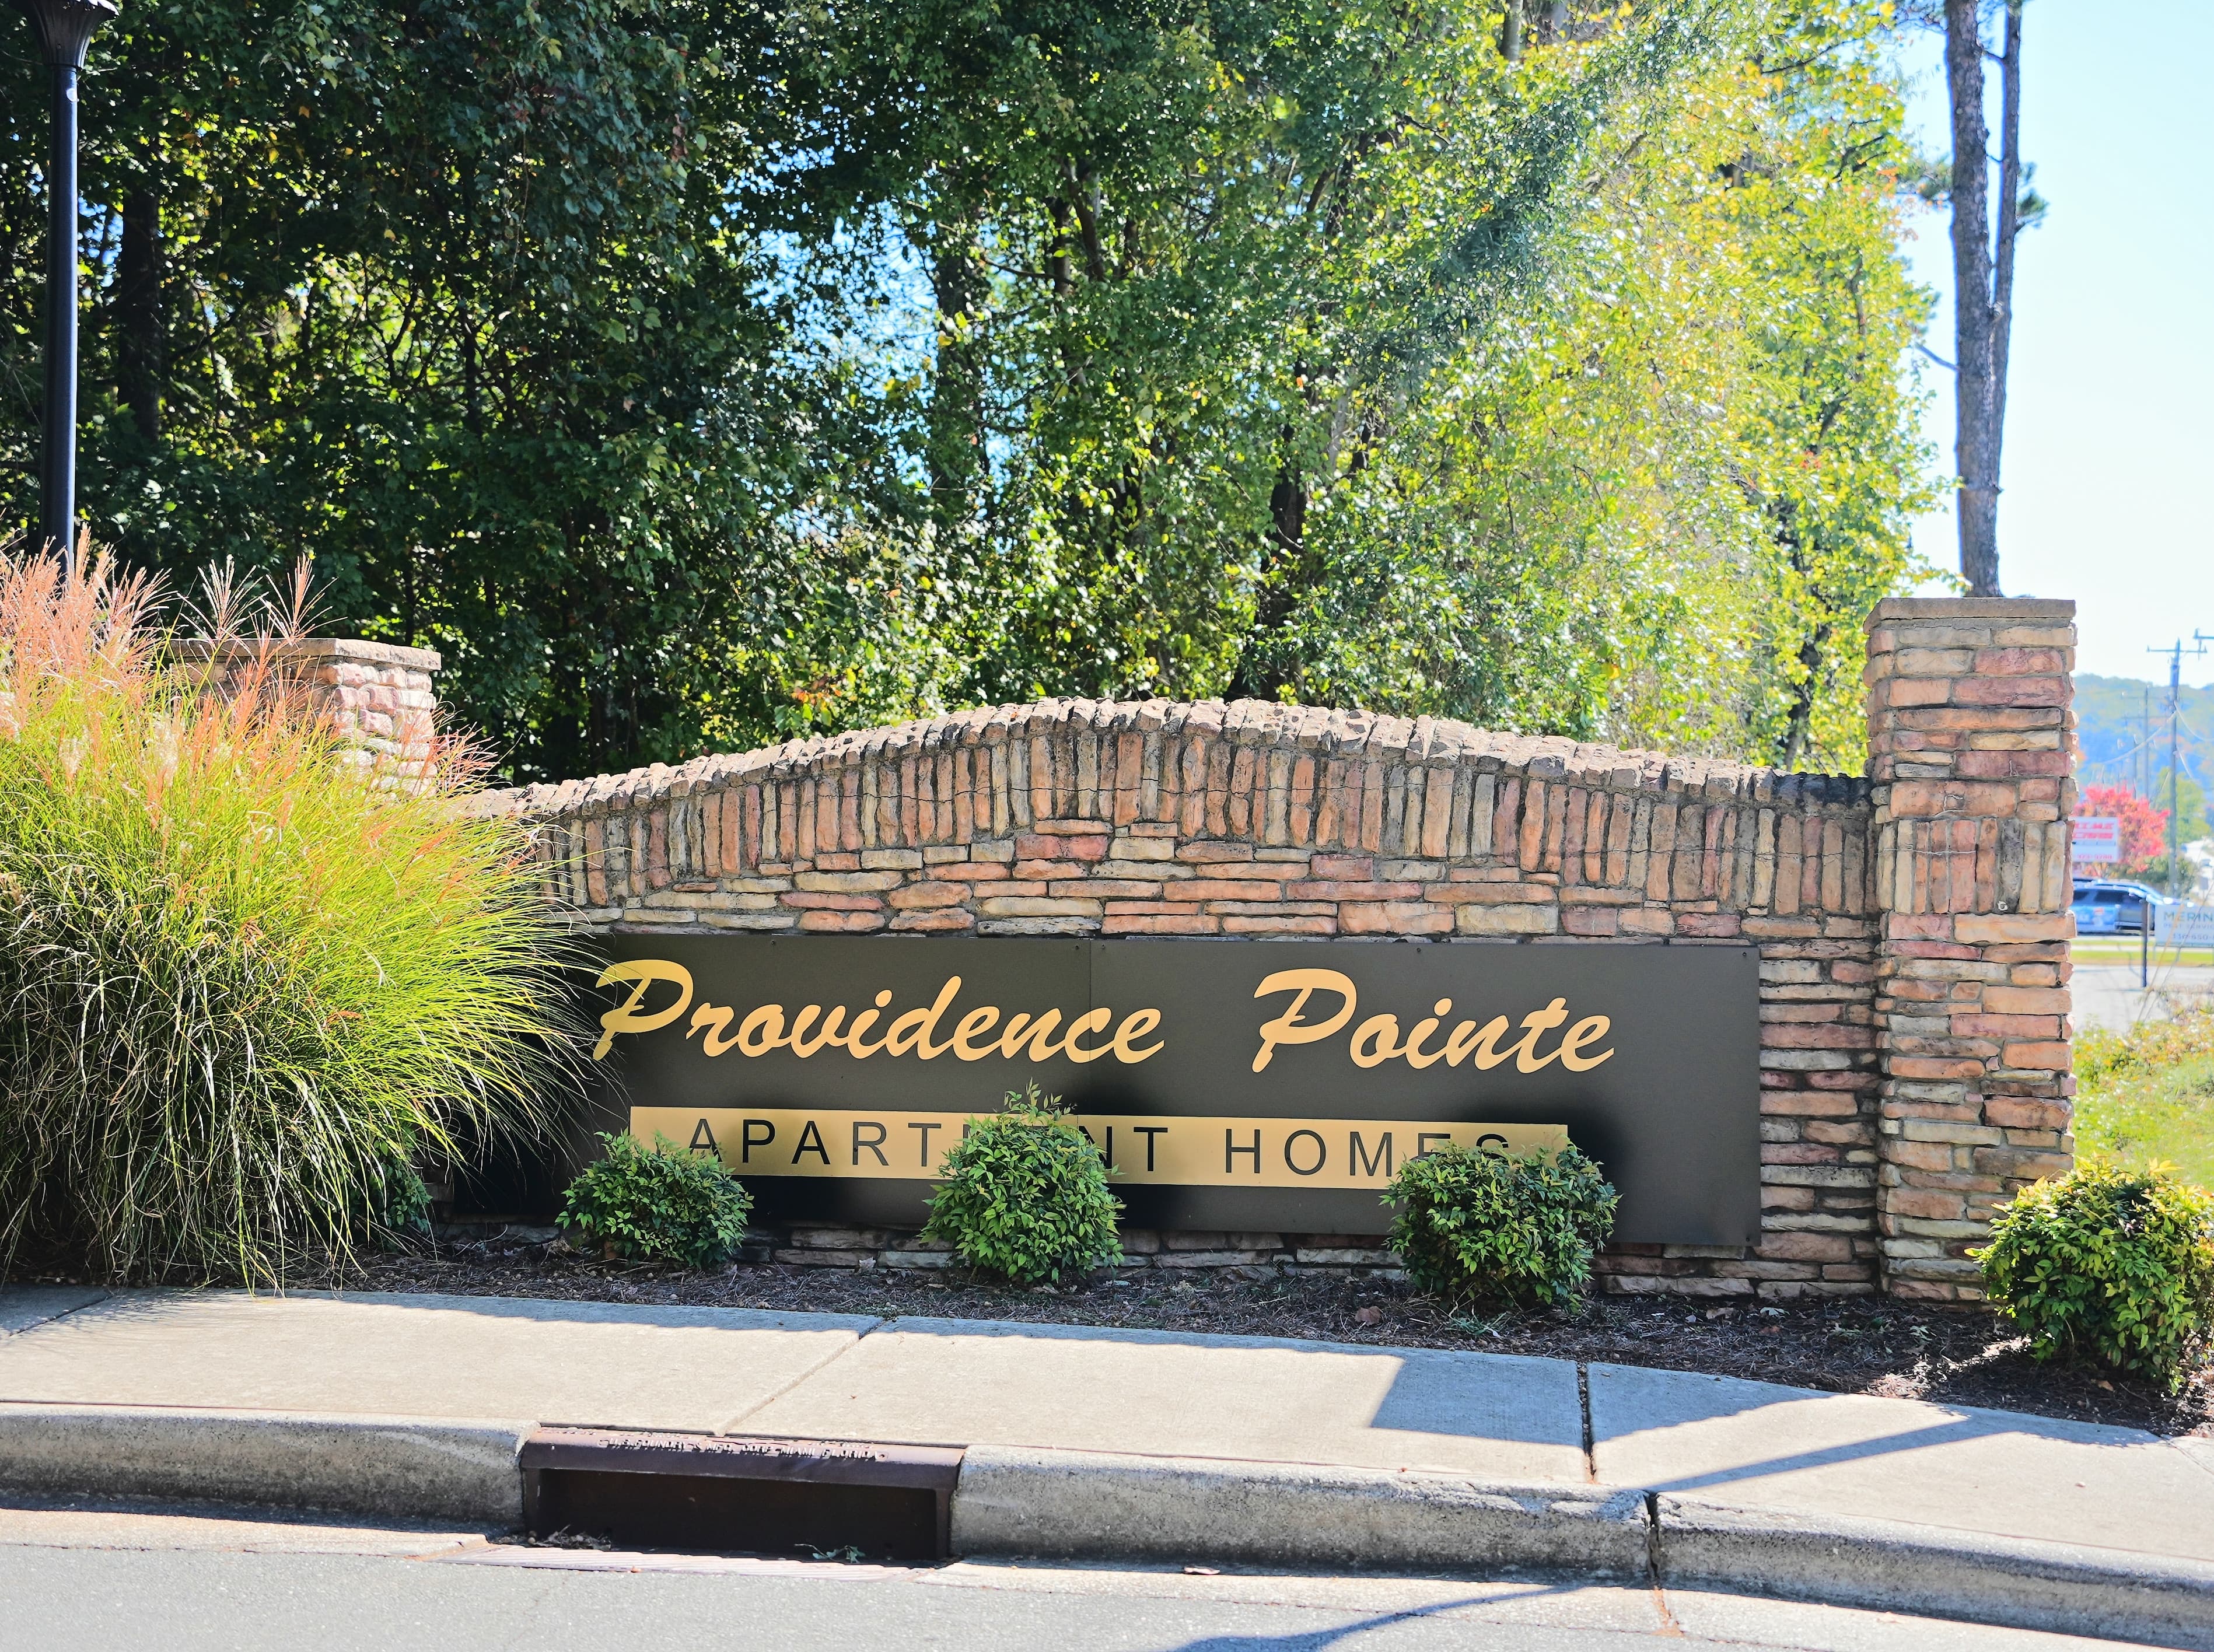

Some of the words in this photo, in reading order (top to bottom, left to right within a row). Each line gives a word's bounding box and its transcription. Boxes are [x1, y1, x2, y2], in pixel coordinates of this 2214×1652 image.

[593, 960, 1164, 1064] Providence
[1251, 968, 1614, 1073] Pointe
[689, 1118, 1168, 1172] APARTNT
